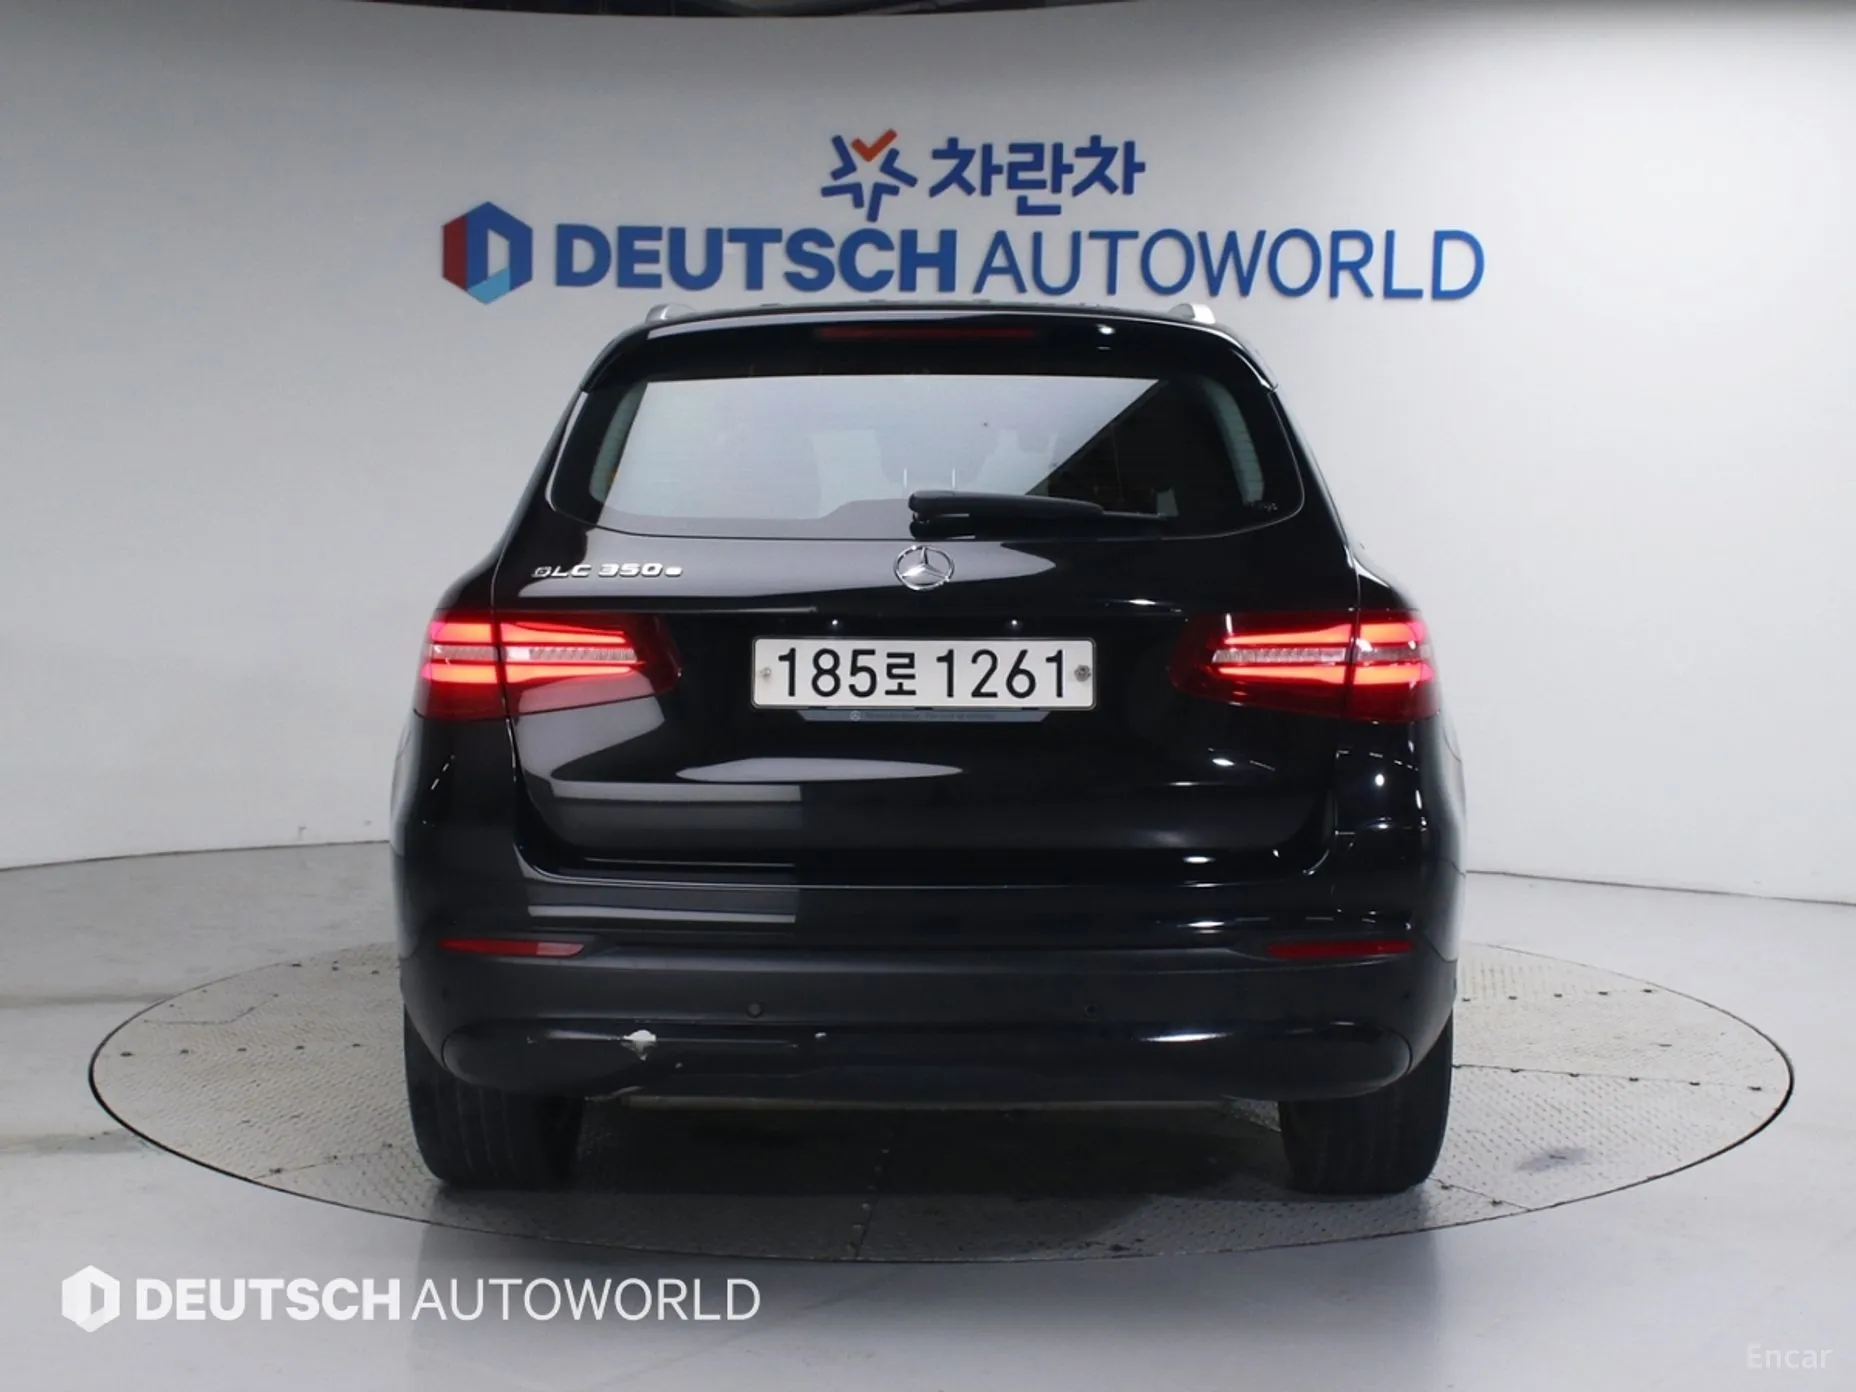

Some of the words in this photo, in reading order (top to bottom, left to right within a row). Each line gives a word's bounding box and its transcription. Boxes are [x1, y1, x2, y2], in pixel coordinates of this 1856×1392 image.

[928, 135, 1146, 216] 차란차
[556, 224, 957, 293] DEUTSCH
[973, 228, 1485, 300] AUTOWORLD
[531, 565, 592, 578] GLC
[778, 647, 917, 698] 185로
[936, 648, 1064, 699] 1261
